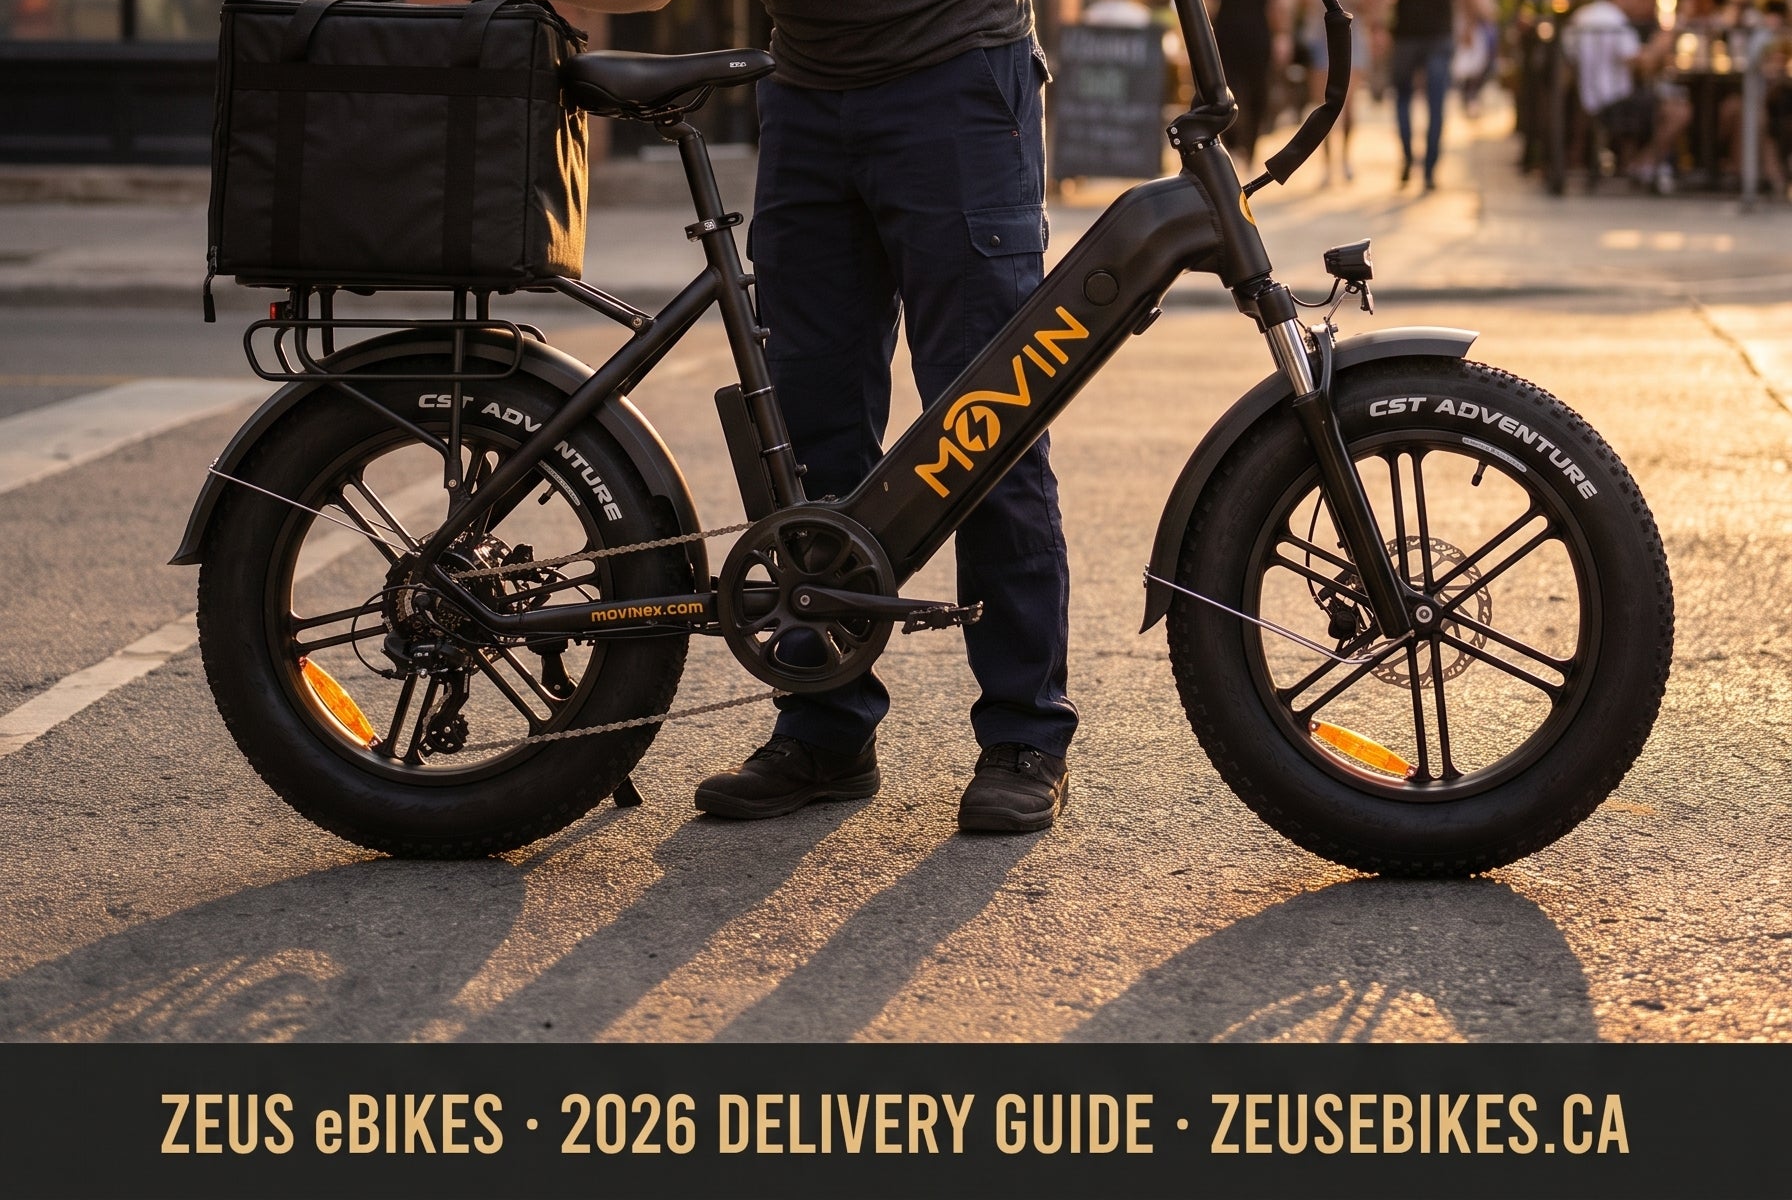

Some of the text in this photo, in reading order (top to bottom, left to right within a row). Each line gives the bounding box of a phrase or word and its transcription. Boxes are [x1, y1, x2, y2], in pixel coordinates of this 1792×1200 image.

[914, 305, 1090, 498] MOVIN
[1369, 397, 1427, 417] CST
[1434, 399, 1598, 500] ADVENTURE
[481, 402, 623, 522] ADVNTURE
